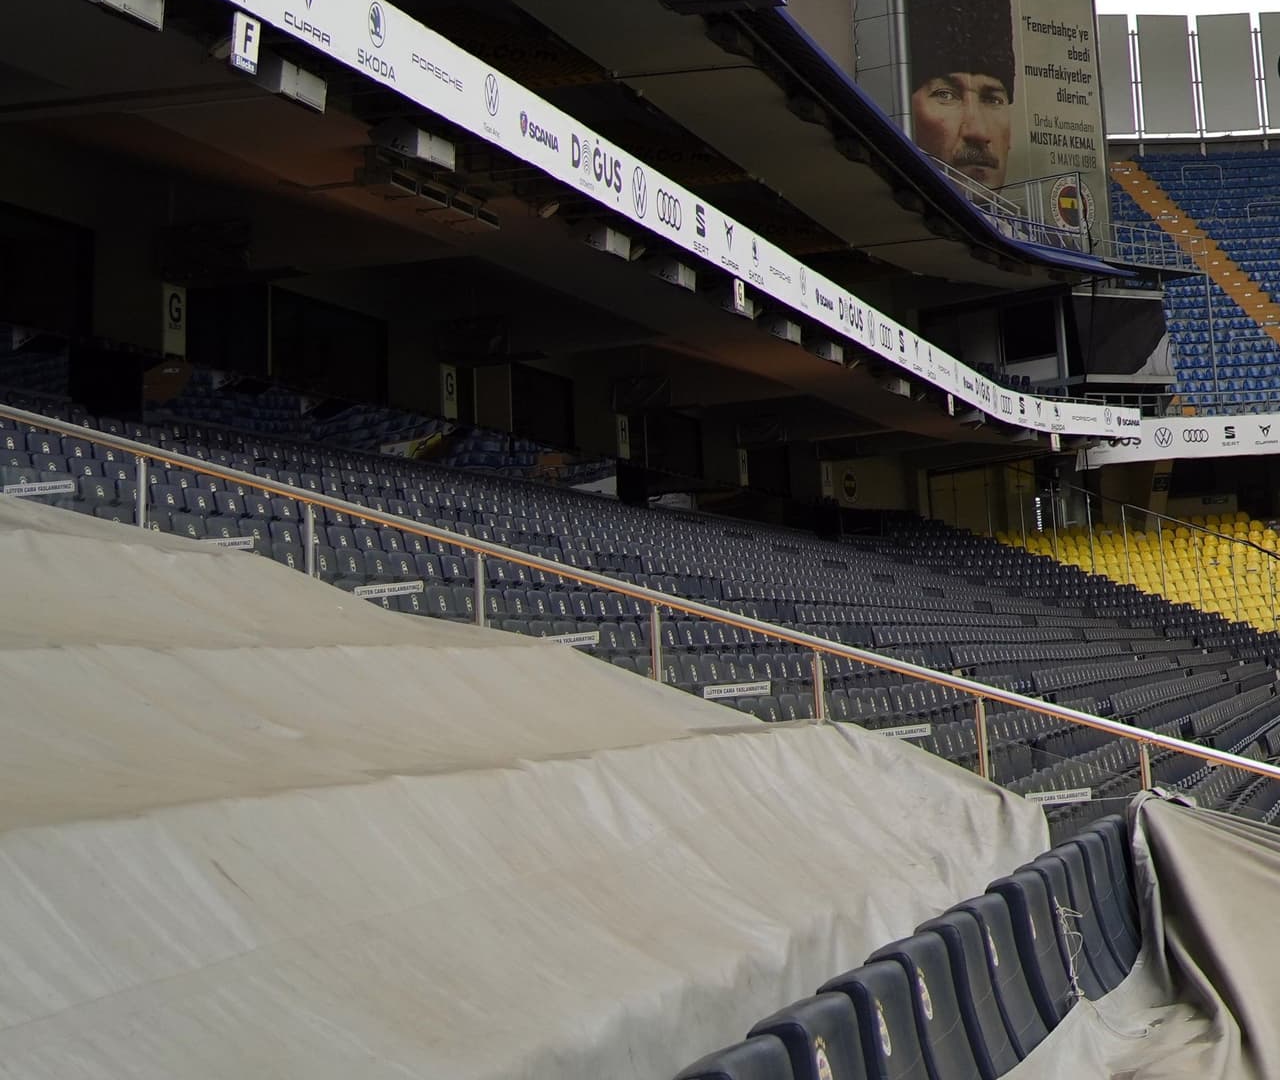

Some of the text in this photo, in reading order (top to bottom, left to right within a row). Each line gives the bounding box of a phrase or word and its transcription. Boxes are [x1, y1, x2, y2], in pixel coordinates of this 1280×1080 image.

[244, 22, 254, 53] F
[284, 11, 331, 48] CUPRA
[1068, 47, 1091, 63] ebedi
[411, 52, 463, 93] PORSCHE
[1025, 64, 1092, 85] muvaffakiyetler
[528, 121, 560, 153] SCANIA
[1030, 131, 1096, 151] MUSTAFA KEMAL
[169, 293, 181, 322] G
